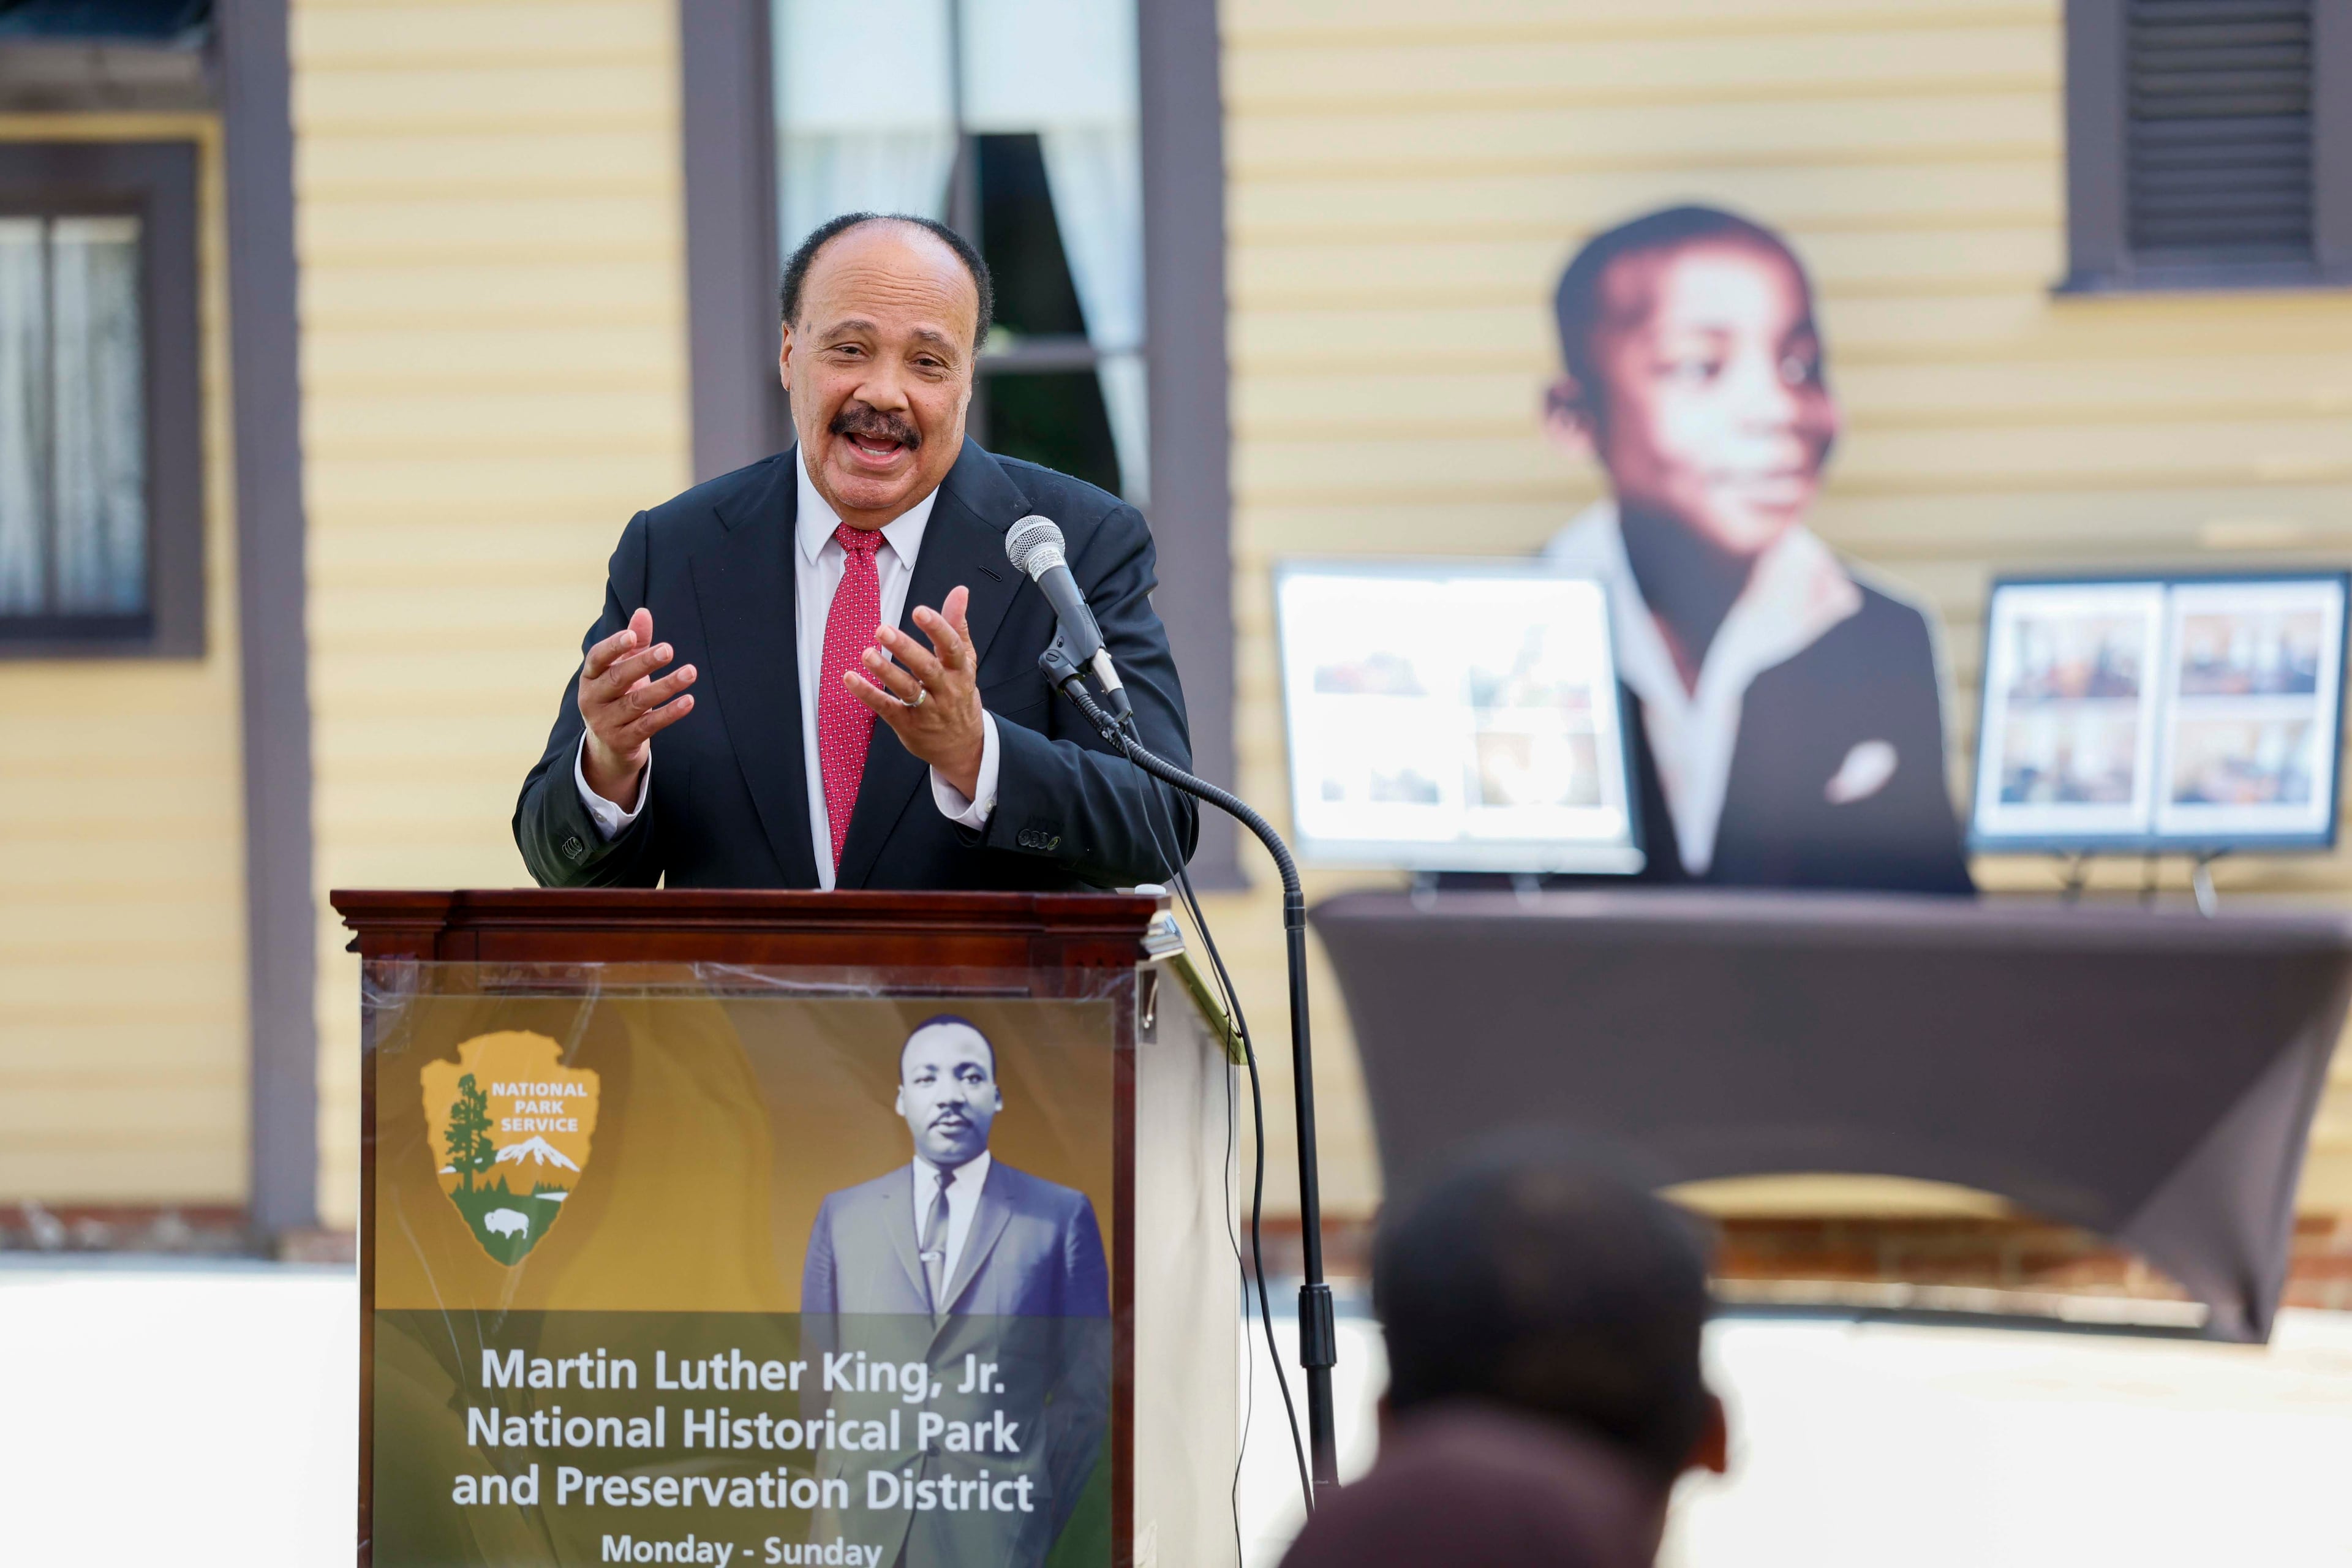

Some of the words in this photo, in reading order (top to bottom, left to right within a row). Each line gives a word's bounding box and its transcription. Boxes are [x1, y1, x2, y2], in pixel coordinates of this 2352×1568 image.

[492, 1082, 587, 1097] NATIONAL
[514, 1099, 564, 1114] PARK
[501, 1117, 578, 1132] SERVICE
[482, 1348, 637, 1389] Martin
[656, 1349, 807, 1391] Luther
[823, 1351, 943, 1404] King,
[957, 1354, 1005, 1393] Jr.
[467, 1406, 665, 1448] National
[684, 1408, 900, 1452] Historical
[918, 1410, 1020, 1452] Park
[452, 1464, 539, 1506] and
[557, 1466, 848, 1509] Preservation
[867, 1468, 1034, 1512] District
[602, 1534, 733, 1568] Monday
[765, 1536, 883, 1568] Sunday
